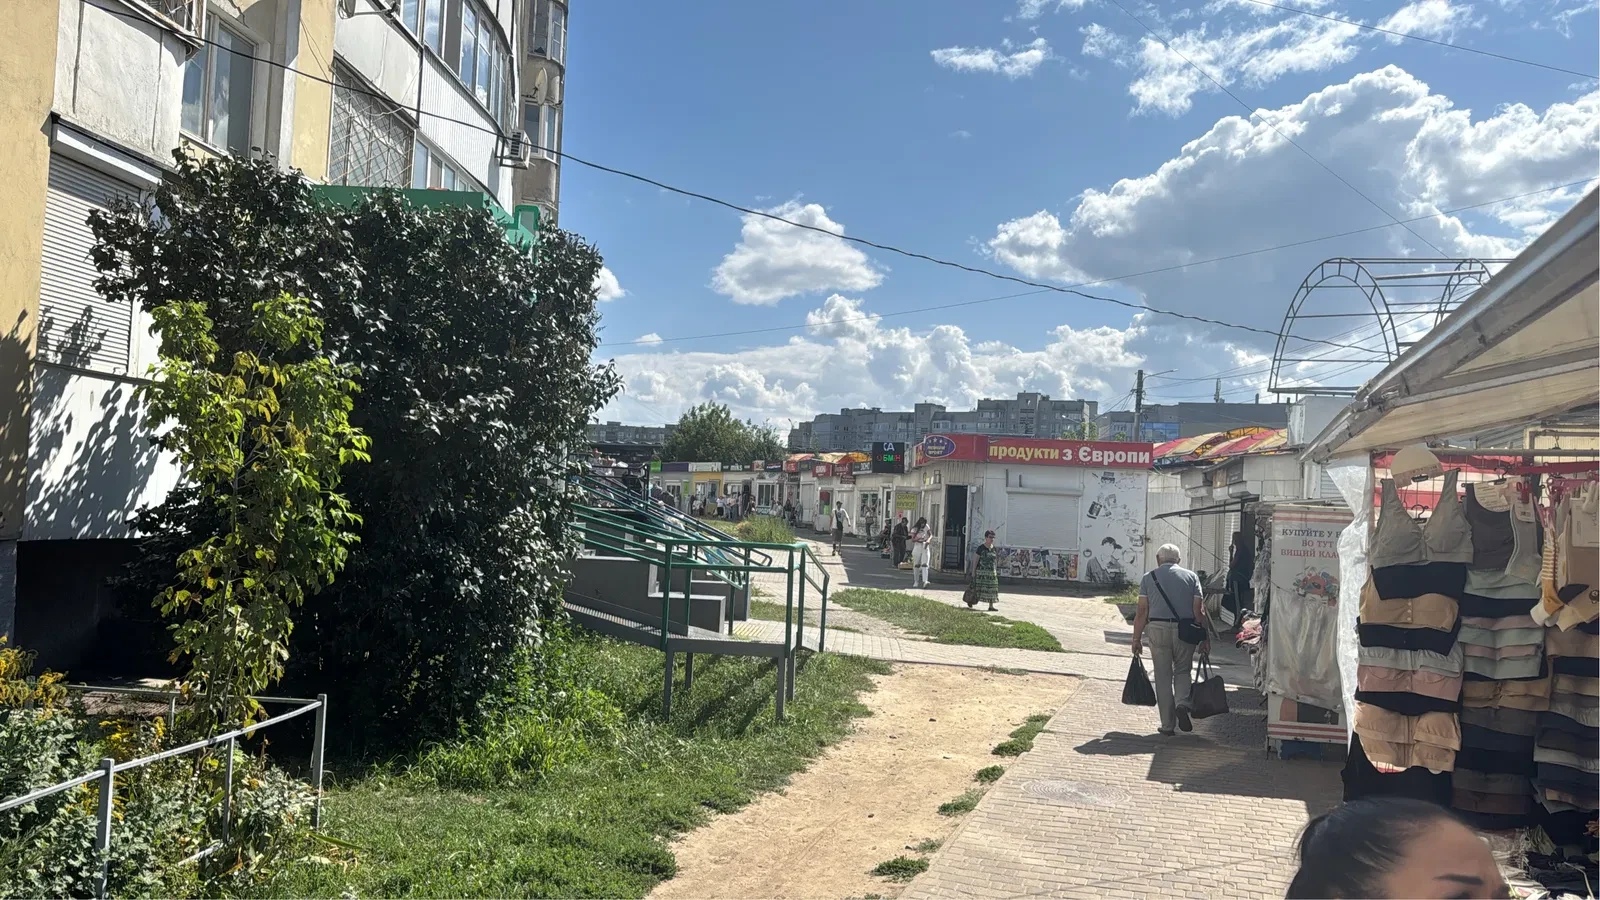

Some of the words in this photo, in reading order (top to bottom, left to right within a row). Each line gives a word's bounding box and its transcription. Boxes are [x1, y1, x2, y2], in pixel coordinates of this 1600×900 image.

[989, 446, 1059, 461] продукти
[1062, 449, 1072, 460] з
[1078, 446, 1150, 465] Європи
[1282, 528, 1325, 538] КУПУЙТЕ
[1281, 549, 1315, 557] ВИЩИЙ
